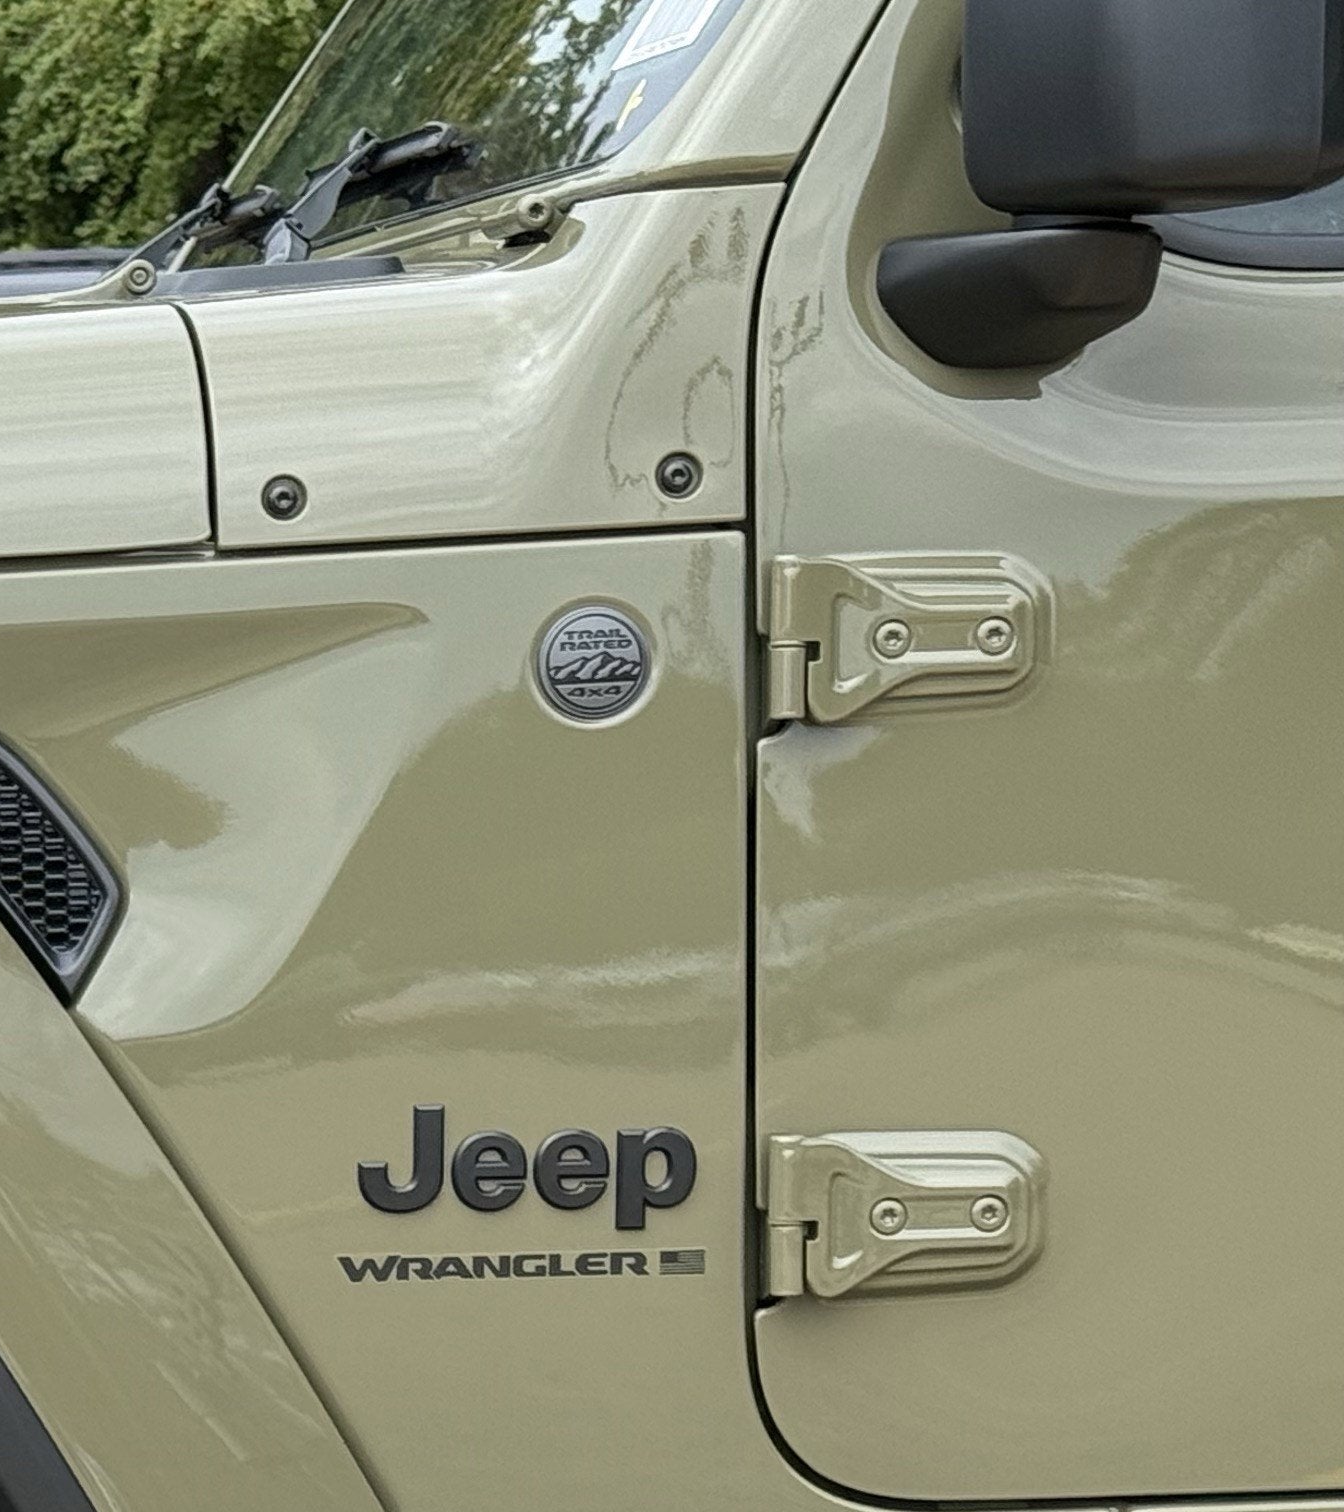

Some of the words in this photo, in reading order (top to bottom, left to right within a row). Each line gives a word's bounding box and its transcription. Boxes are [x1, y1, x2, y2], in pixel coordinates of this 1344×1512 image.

[563, 628, 628, 640] TRAIL
[560, 639, 633, 652] RATED
[566, 685, 623, 698] 4x4
[357, 1103, 698, 1231] Jeep
[337, 1251, 650, 1283] WRANGLER
